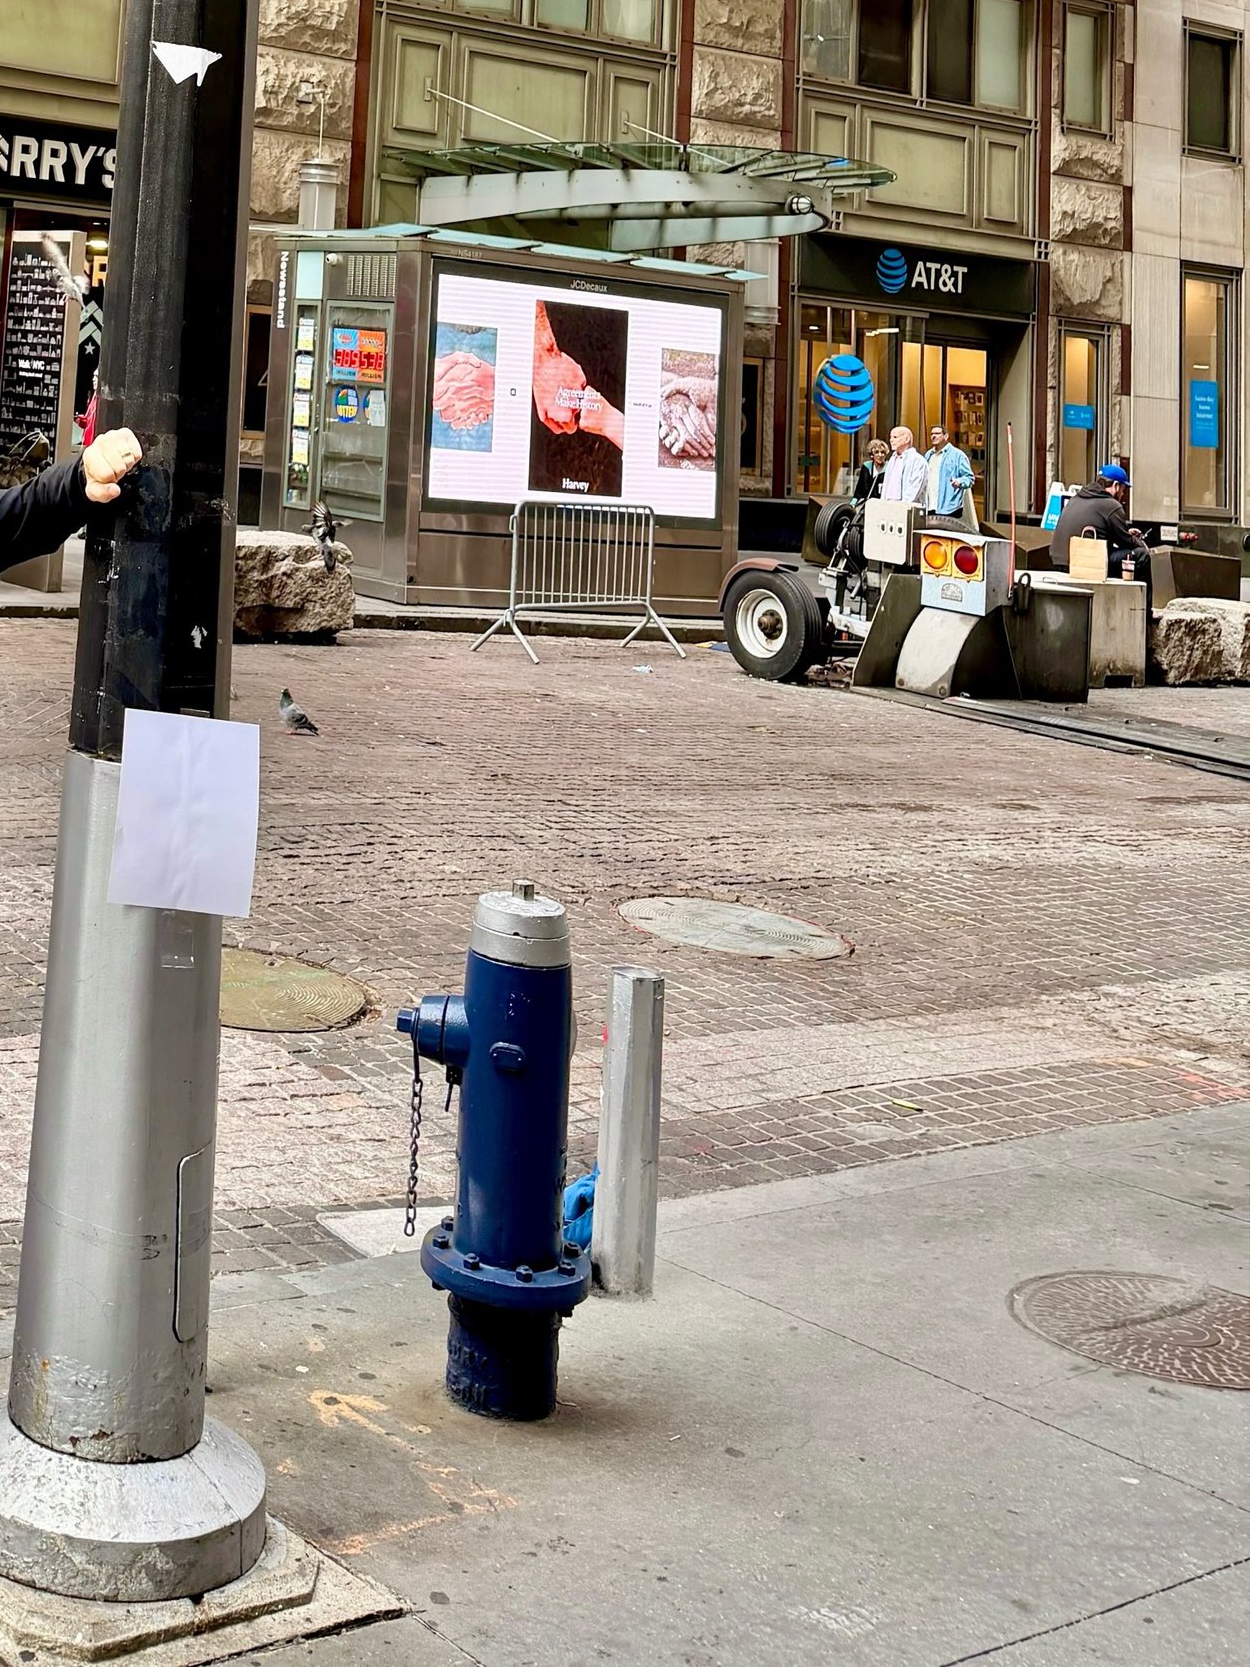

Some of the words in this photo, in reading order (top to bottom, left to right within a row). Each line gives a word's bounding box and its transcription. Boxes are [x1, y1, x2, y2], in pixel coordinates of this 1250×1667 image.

[570, 279, 608, 293] JCDecaux
[911, 261, 968, 294] AT&T
[276, 251, 289, 329] Newsstand
[562, 477, 590, 493] Harvey
